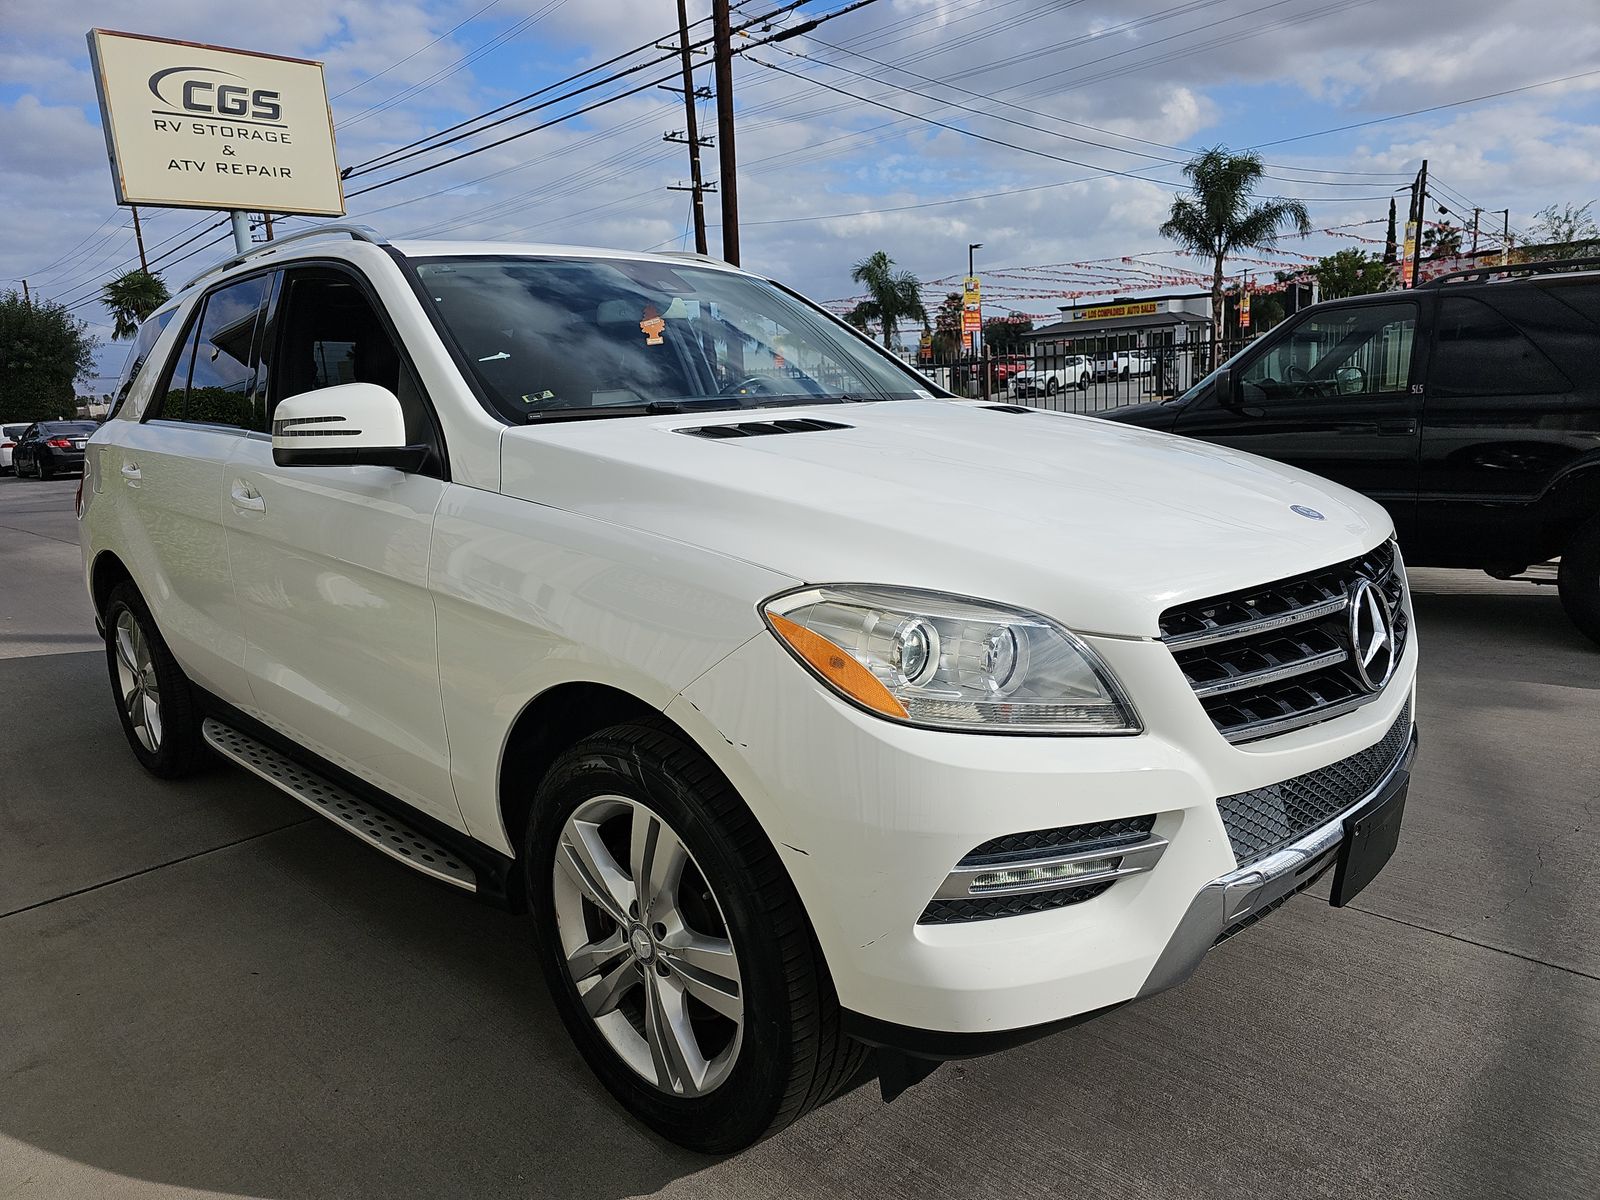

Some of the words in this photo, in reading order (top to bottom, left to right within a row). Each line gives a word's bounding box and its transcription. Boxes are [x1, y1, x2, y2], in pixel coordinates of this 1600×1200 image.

[183, 80, 282, 121] CGS
[154, 119, 182, 132] RV
[193, 124, 292, 144] STORAGE
[222, 145, 237, 156] &
[168, 159, 206, 172] ATV
[216, 162, 292, 178] REPAIR
[1088, 310, 1097, 319] LOS
[1127, 305, 1140, 315] AUTO
[1141, 303, 1156, 313] SALES
